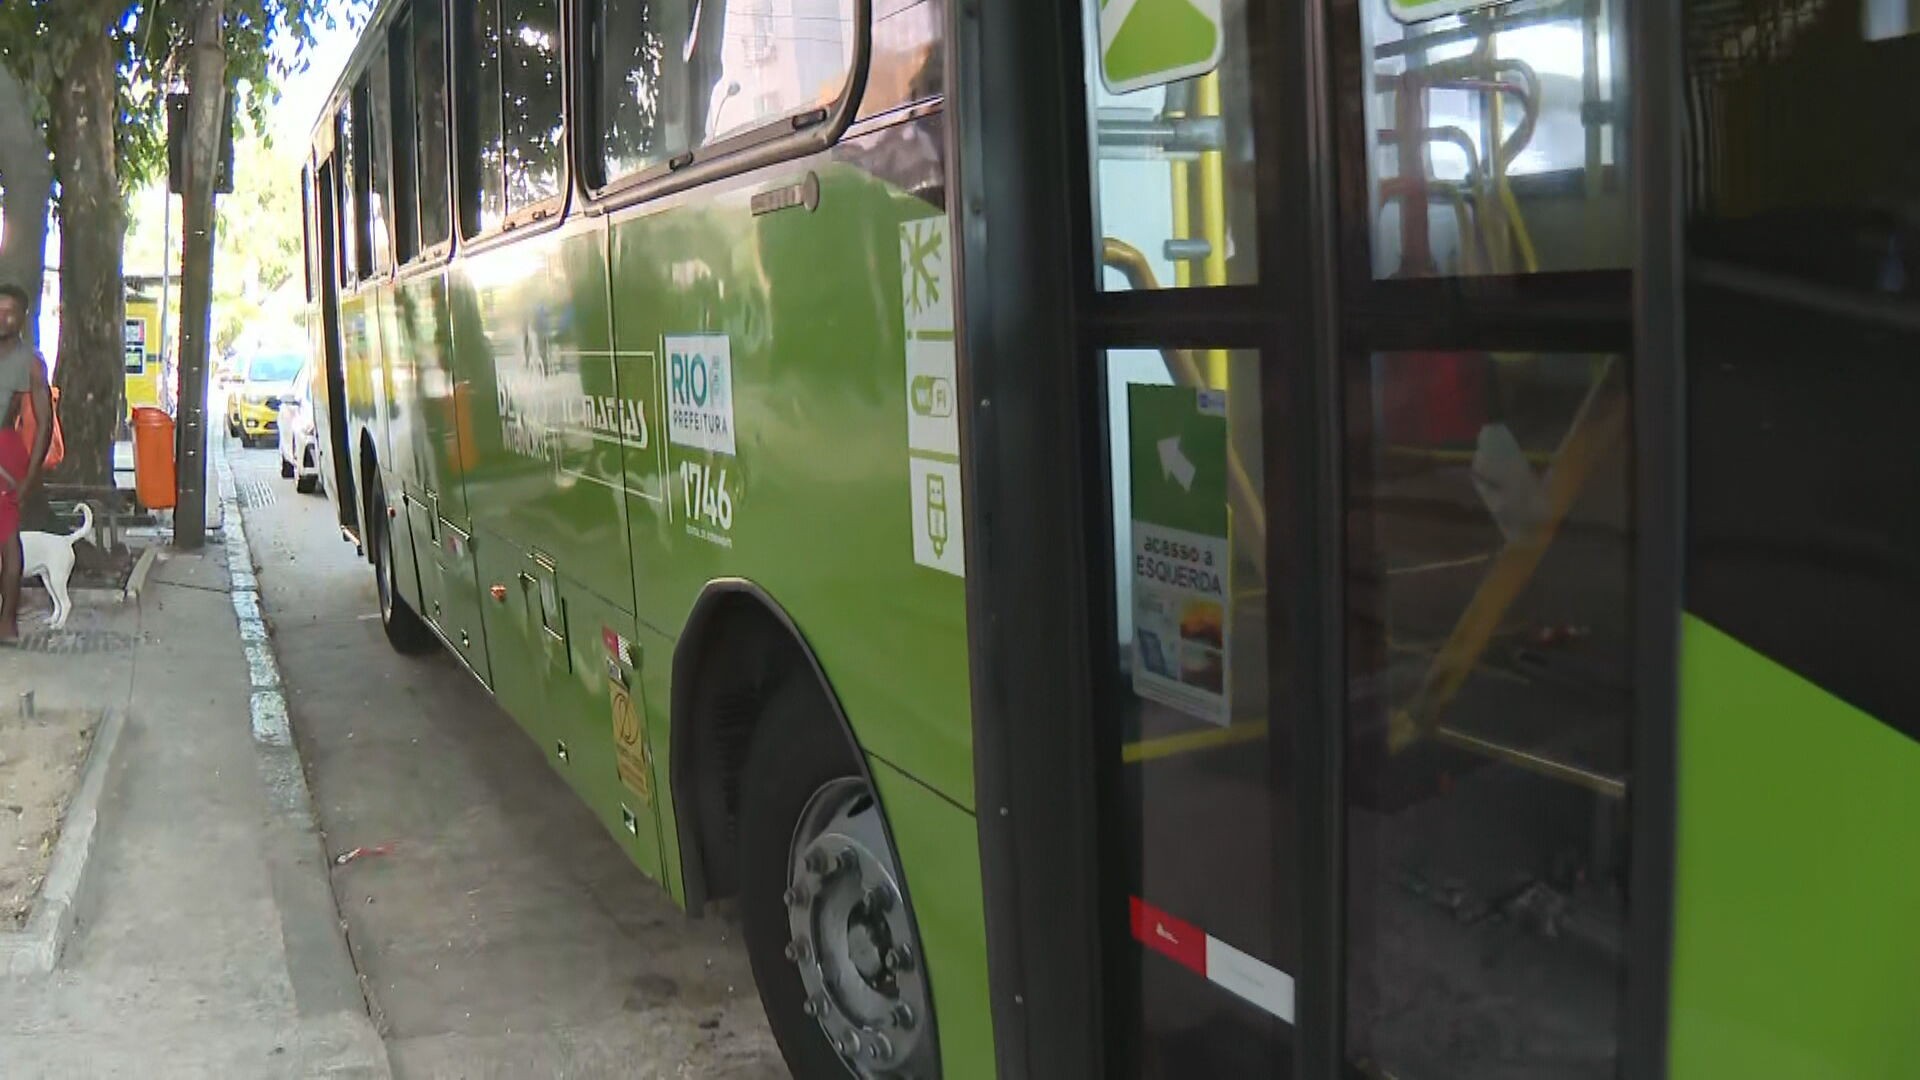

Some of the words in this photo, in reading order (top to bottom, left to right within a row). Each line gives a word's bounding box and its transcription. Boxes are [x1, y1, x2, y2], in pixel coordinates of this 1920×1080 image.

[671, 351, 707, 407] RIO
[673, 410, 728, 435] PREFEITURA
[680, 460, 733, 530] 1746
[1136, 554, 1222, 595] ESQUERDA
